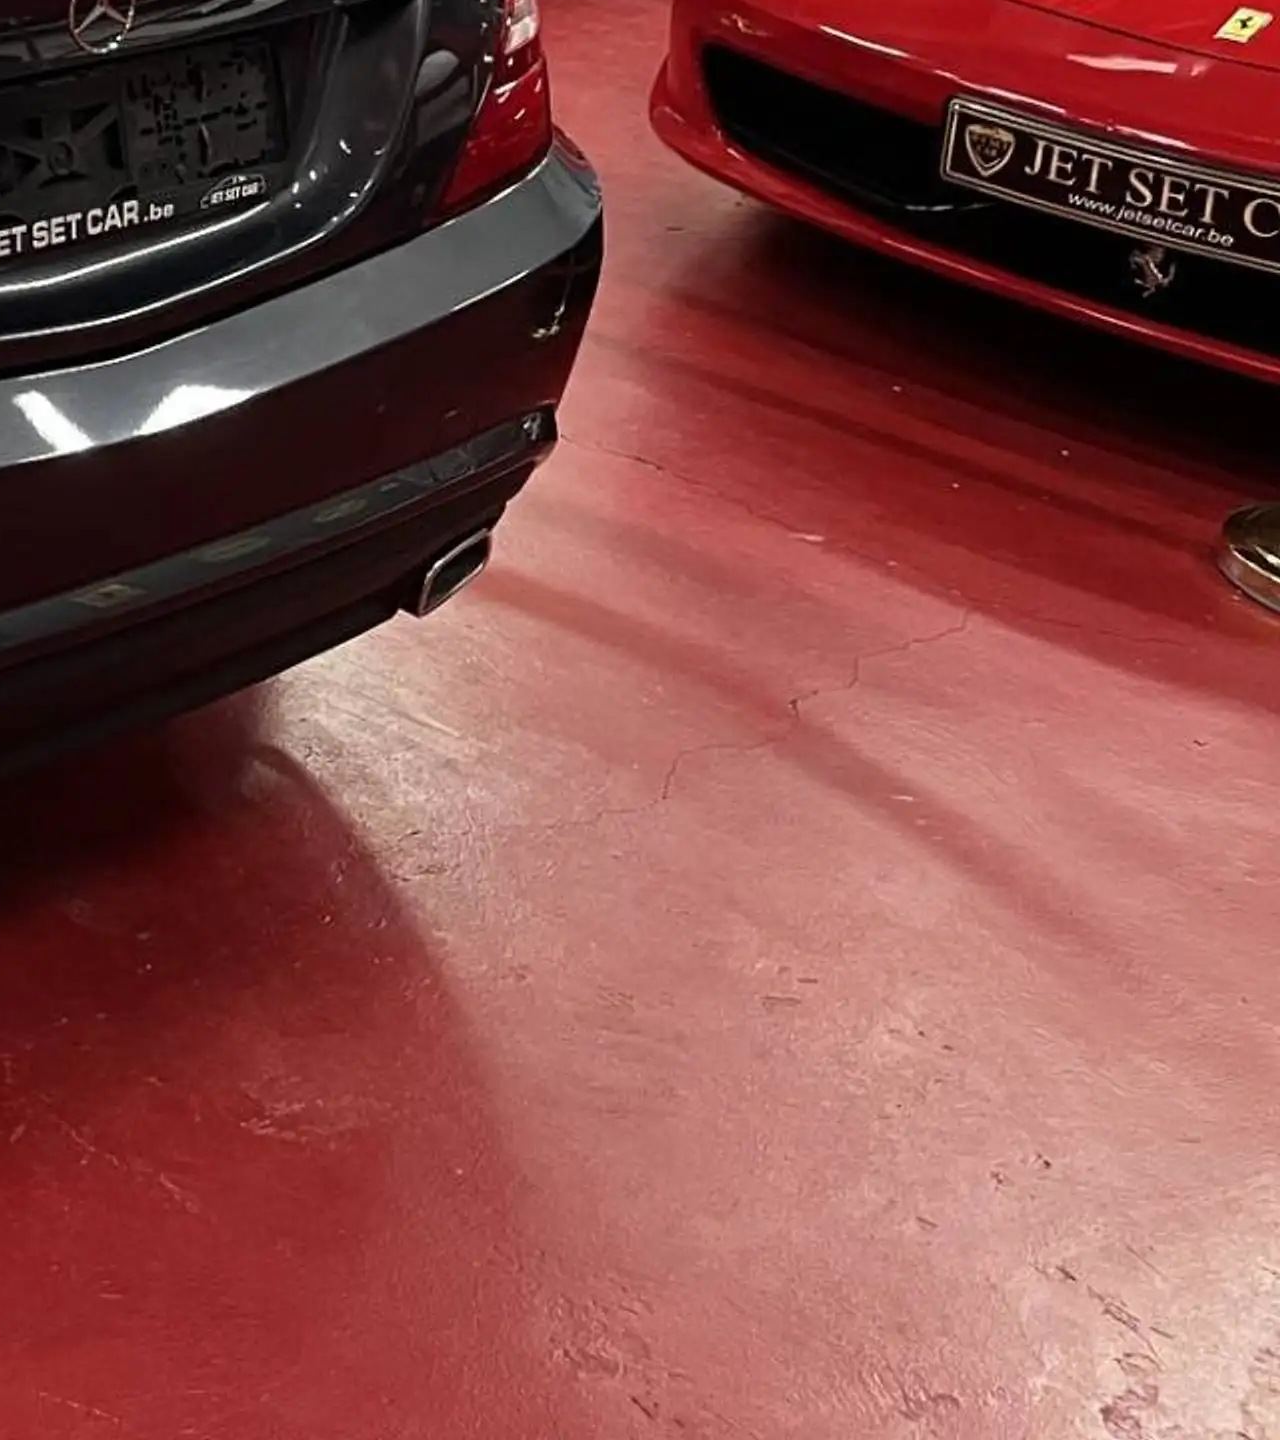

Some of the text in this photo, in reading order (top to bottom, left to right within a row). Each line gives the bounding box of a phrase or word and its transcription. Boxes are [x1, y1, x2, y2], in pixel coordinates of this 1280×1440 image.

[1024, 140, 1113, 195] JET
[1125, 167, 1230, 224] SET
[32, 213, 83, 249] SET
[1068, 192, 1235, 248] www.jetsetcar.be
